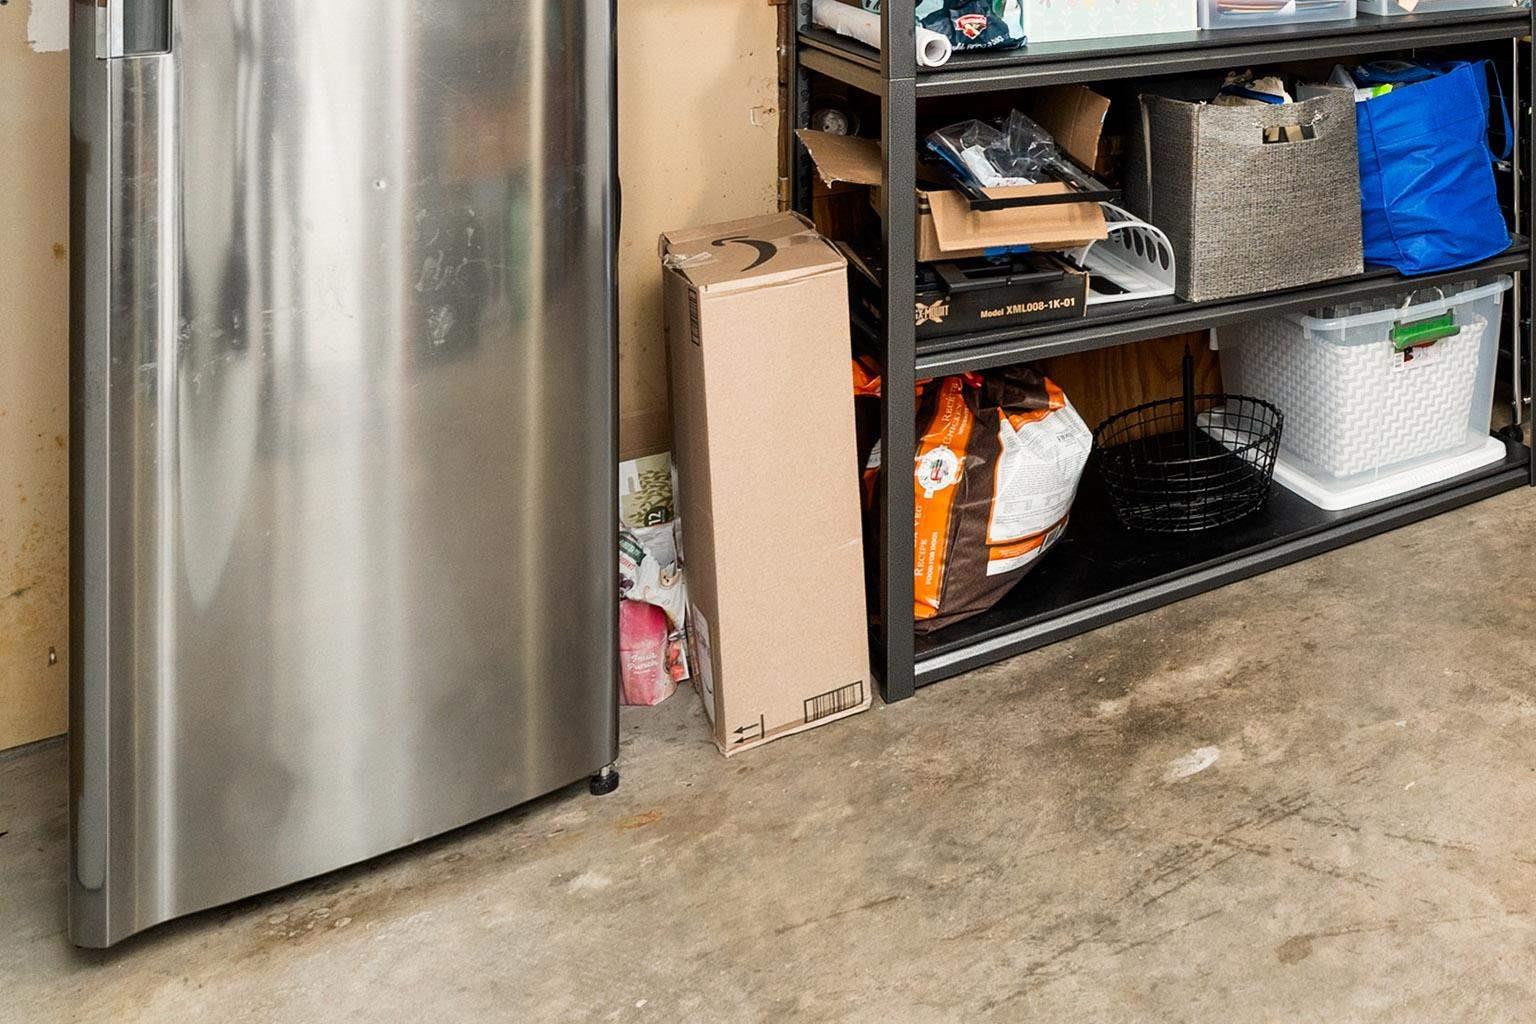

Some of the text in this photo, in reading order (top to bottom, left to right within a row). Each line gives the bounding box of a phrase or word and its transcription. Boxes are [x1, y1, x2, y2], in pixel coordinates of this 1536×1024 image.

[980, 297, 1076, 319] Model XML008-1K-01
[925, 564, 934, 585] FOOD
